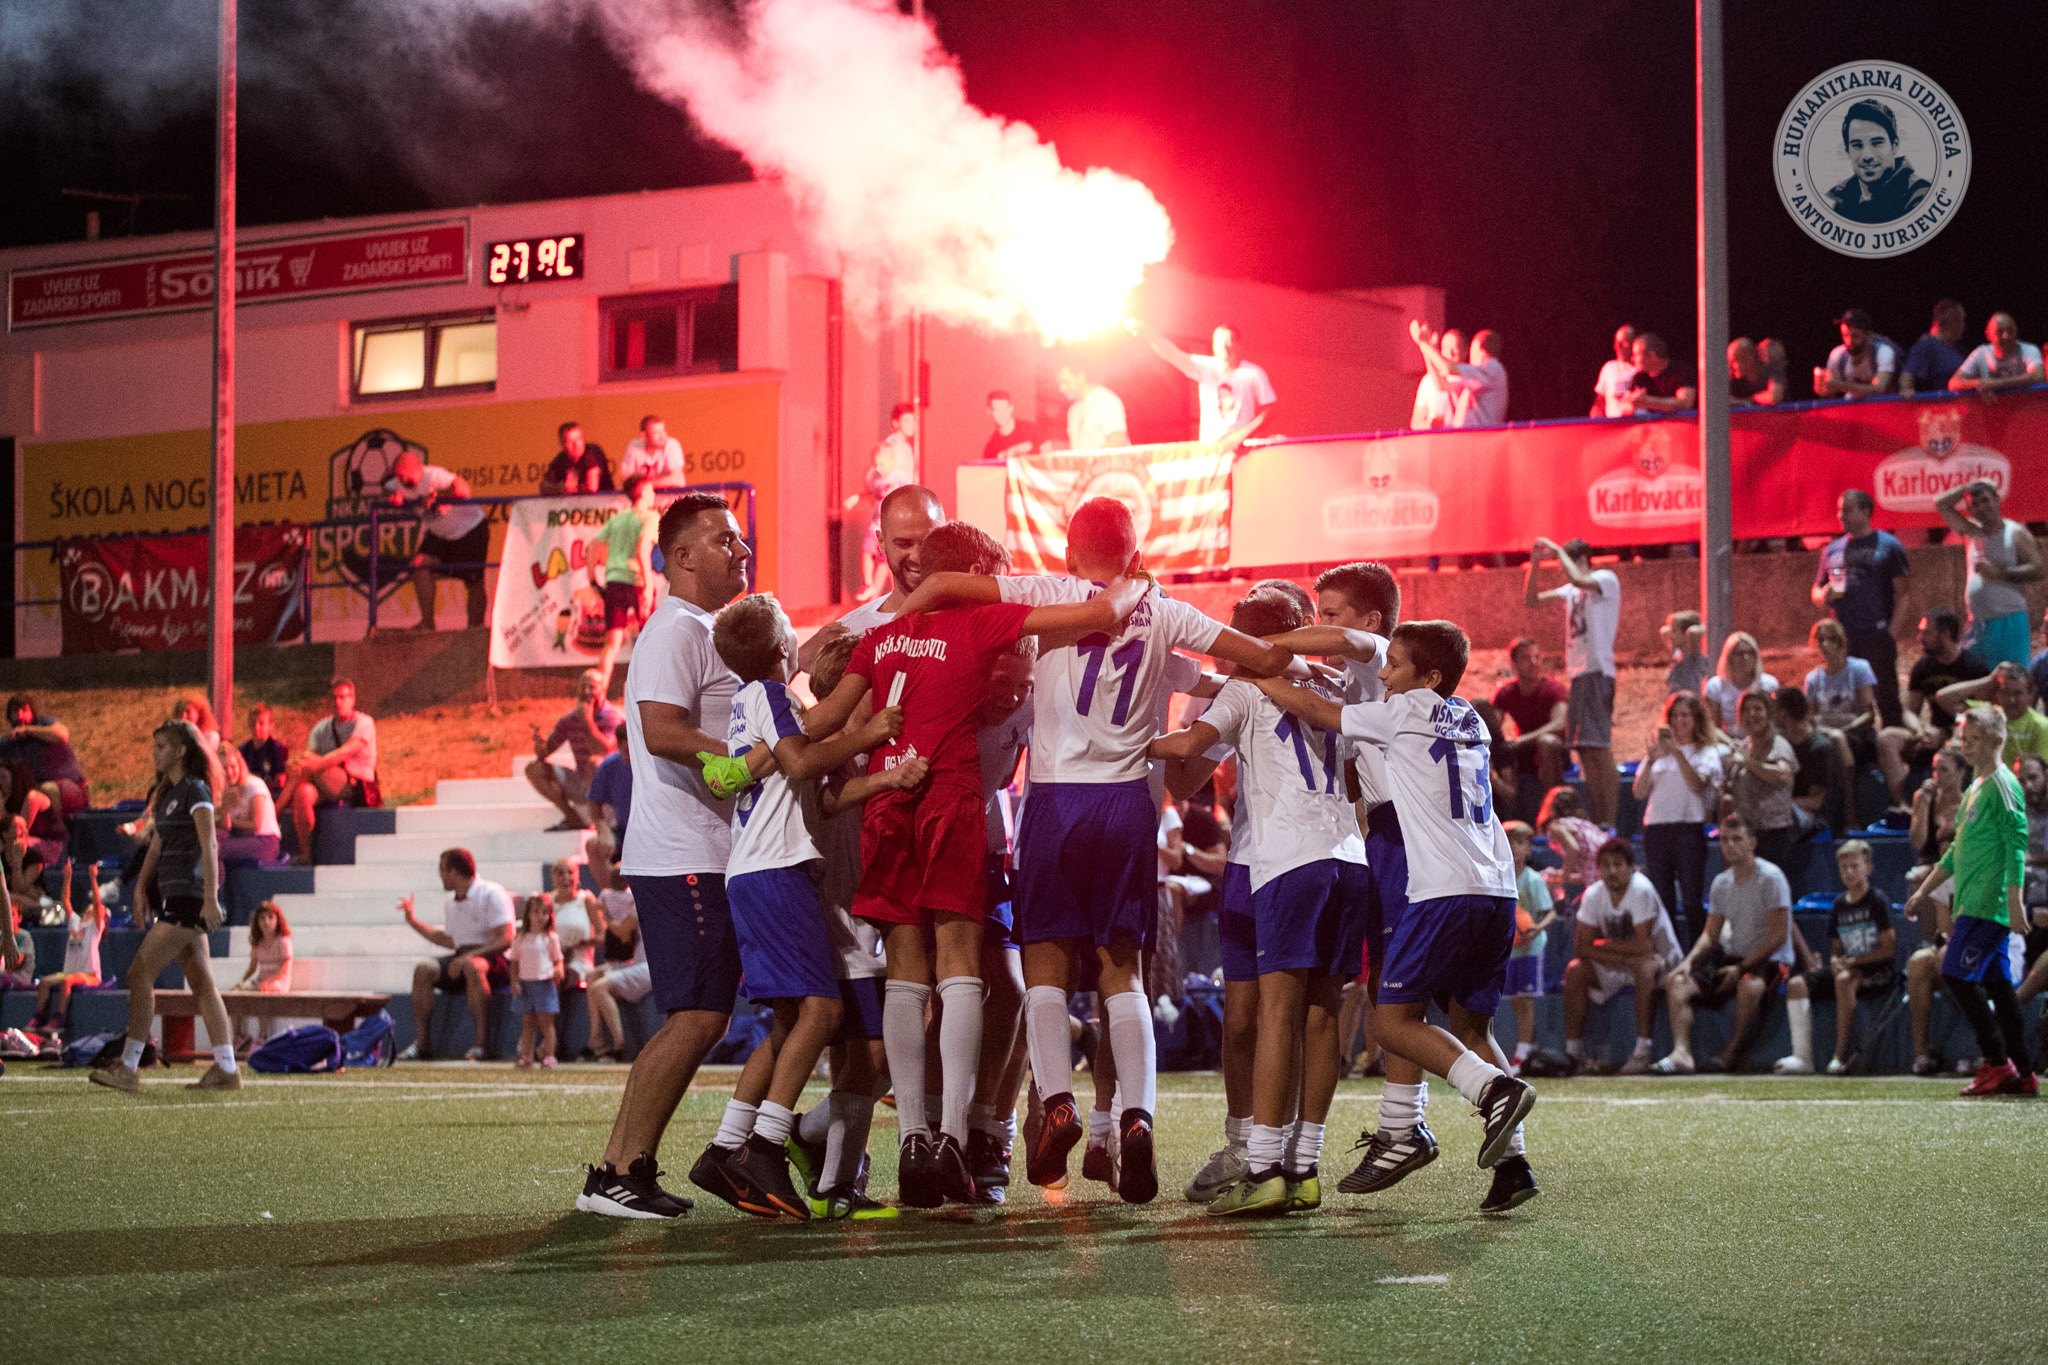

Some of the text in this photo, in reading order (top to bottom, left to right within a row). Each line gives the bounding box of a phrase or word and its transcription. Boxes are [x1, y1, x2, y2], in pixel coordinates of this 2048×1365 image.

[700, 448, 746, 473] GOD
[50, 470, 307, 519] ŠKOLA NOGMETA
[1076, 631, 1146, 727] 11
[1428, 738, 1492, 824] 13
